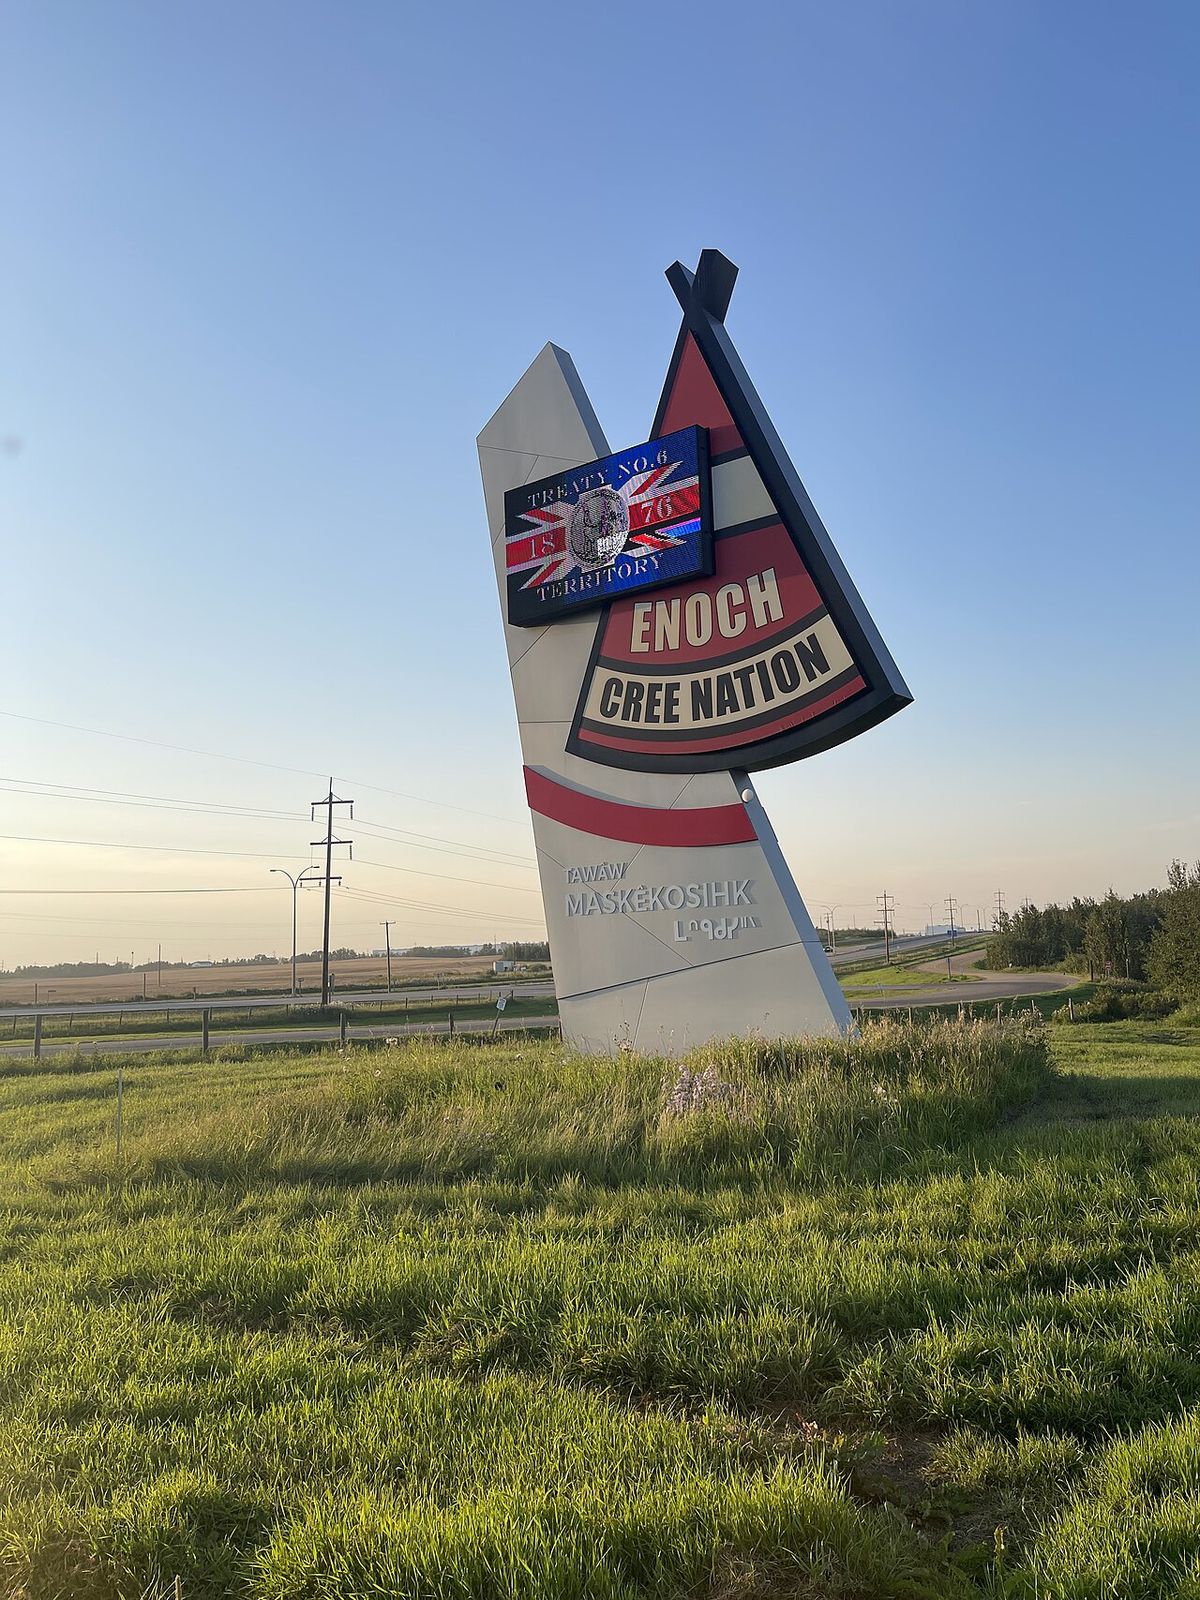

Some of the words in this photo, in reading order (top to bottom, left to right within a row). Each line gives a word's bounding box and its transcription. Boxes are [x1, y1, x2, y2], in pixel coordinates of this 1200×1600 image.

[527, 468, 609, 508] TREATY
[529, 535, 556, 560] 18
[641, 495, 672, 523] 76
[536, 552, 664, 602] TERRITORY
[630, 567, 784, 653] ENOCH
[600, 677, 680, 724] CREE
[690, 632, 831, 721] NATION
